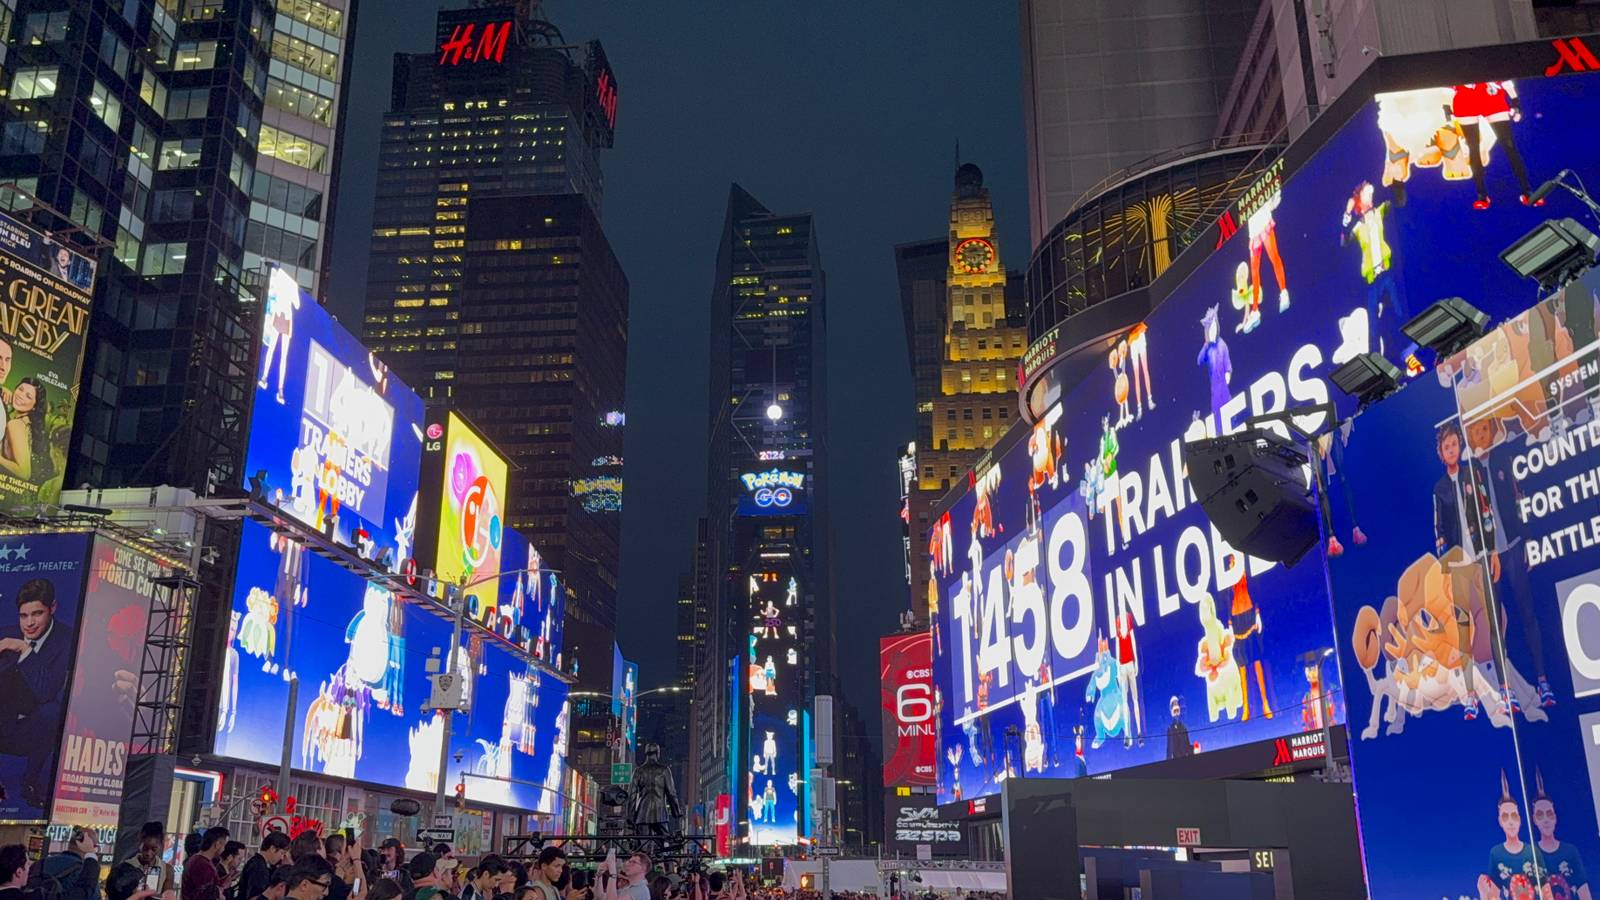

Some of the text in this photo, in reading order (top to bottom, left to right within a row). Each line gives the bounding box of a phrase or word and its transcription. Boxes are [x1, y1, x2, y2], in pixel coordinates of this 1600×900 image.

[440, 20, 513, 65] H&M
[1238, 158, 1284, 211] MARRIOTT
[1239, 178, 1281, 226] MARQUIS
[10, 232, 31, 249] BLEU
[10, 259, 42, 281] ROARING
[43, 276, 55, 288] ON
[54, 283, 91, 305] BROADWAY
[9, 279, 89, 336] GREAT
[1024, 328, 1060, 365] MARRIOTT
[1549, 359, 1599, 396] SYSTEM
[426, 442, 441, 452] LG
[755, 487, 792, 507] GO
[1519, 466, 1600, 524] FOR TH
[98, 559, 135, 591] WORLD
[113, 548, 132, 569] COME
[133, 555, 147, 574] SEE
[953, 511, 1095, 703] 1458
[1104, 545, 1146, 640] IN
[913, 669, 930, 679] CBS
[64, 735, 125, 776] HADES
[1291, 732, 1326, 748] MARRIOT
[1292, 744, 1325, 760] MARQUIS
[1178, 829, 1199, 844] EXIT
